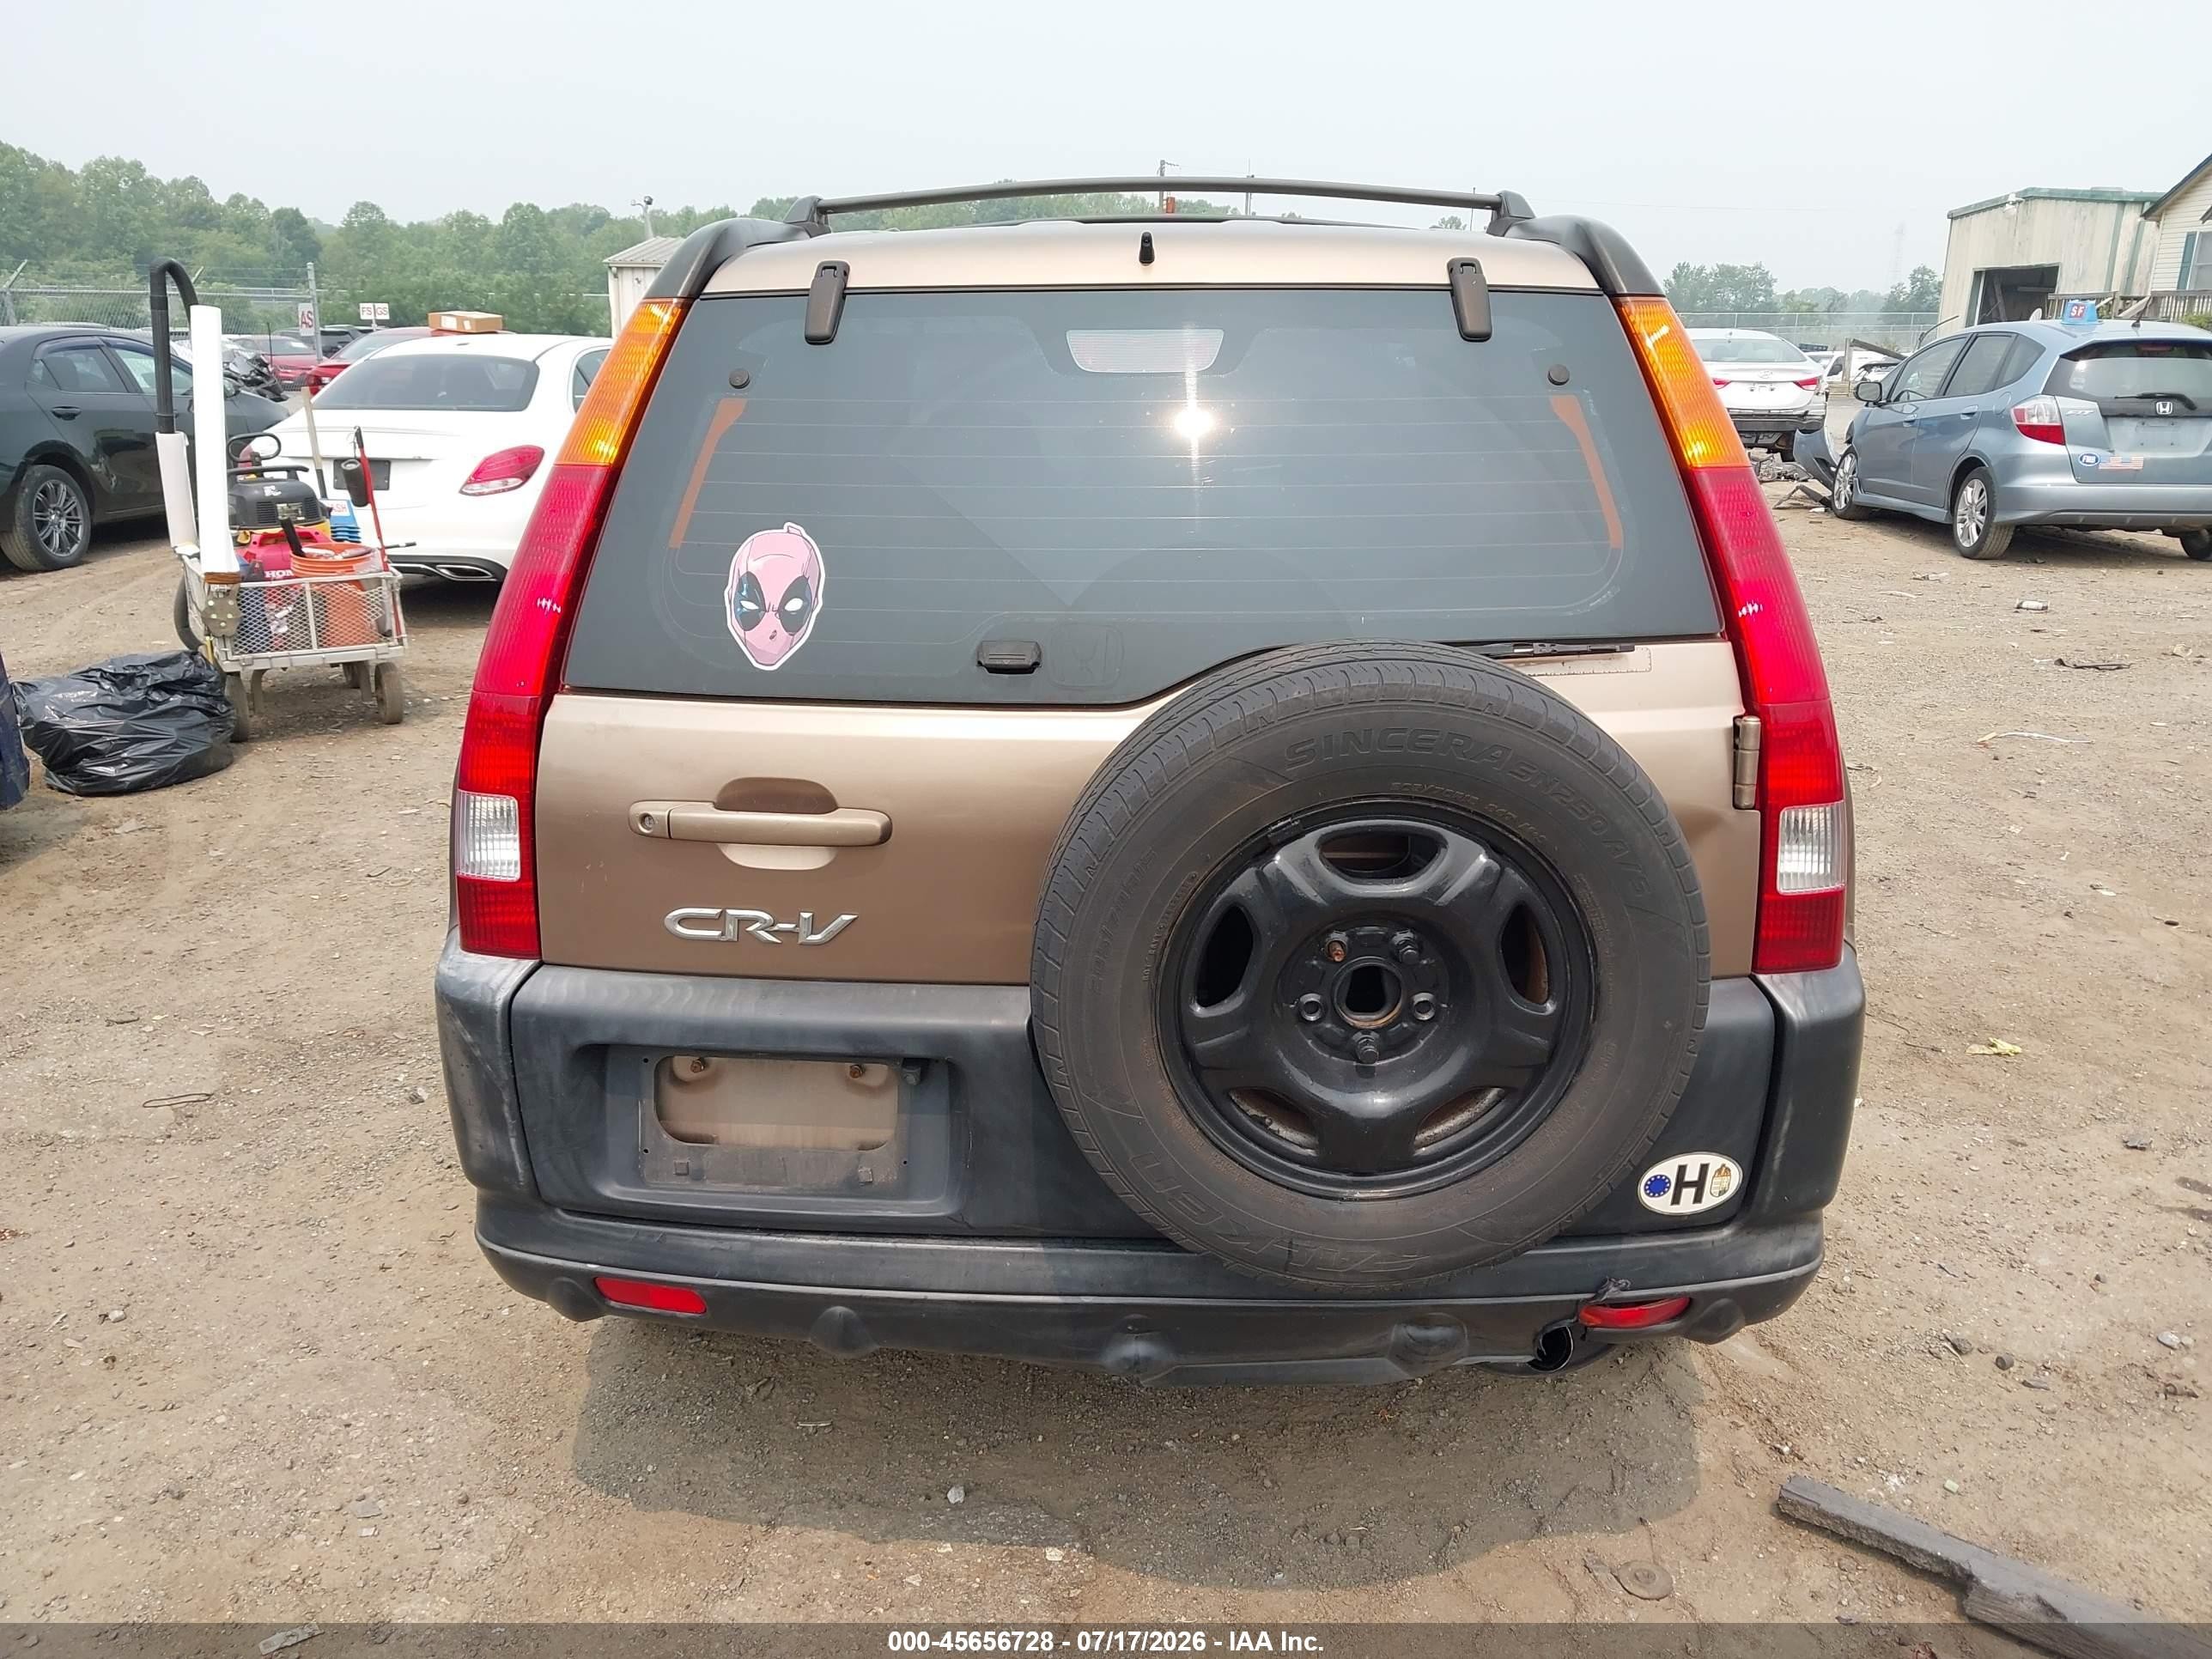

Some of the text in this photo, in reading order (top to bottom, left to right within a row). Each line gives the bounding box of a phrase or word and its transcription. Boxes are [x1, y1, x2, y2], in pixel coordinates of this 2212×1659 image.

[361, 307, 373, 316] FS
[376, 307, 388, 316] GS
[2070, 306, 2085, 317] SF
[301, 310, 313, 329] AS
[264, 569, 295, 578] HON
[1284, 727, 1512, 771] SINCERA
[1509, 761, 1608, 836] SN250
[664, 906, 859, 945] CR-V
[1669, 1162, 1711, 1206] H
